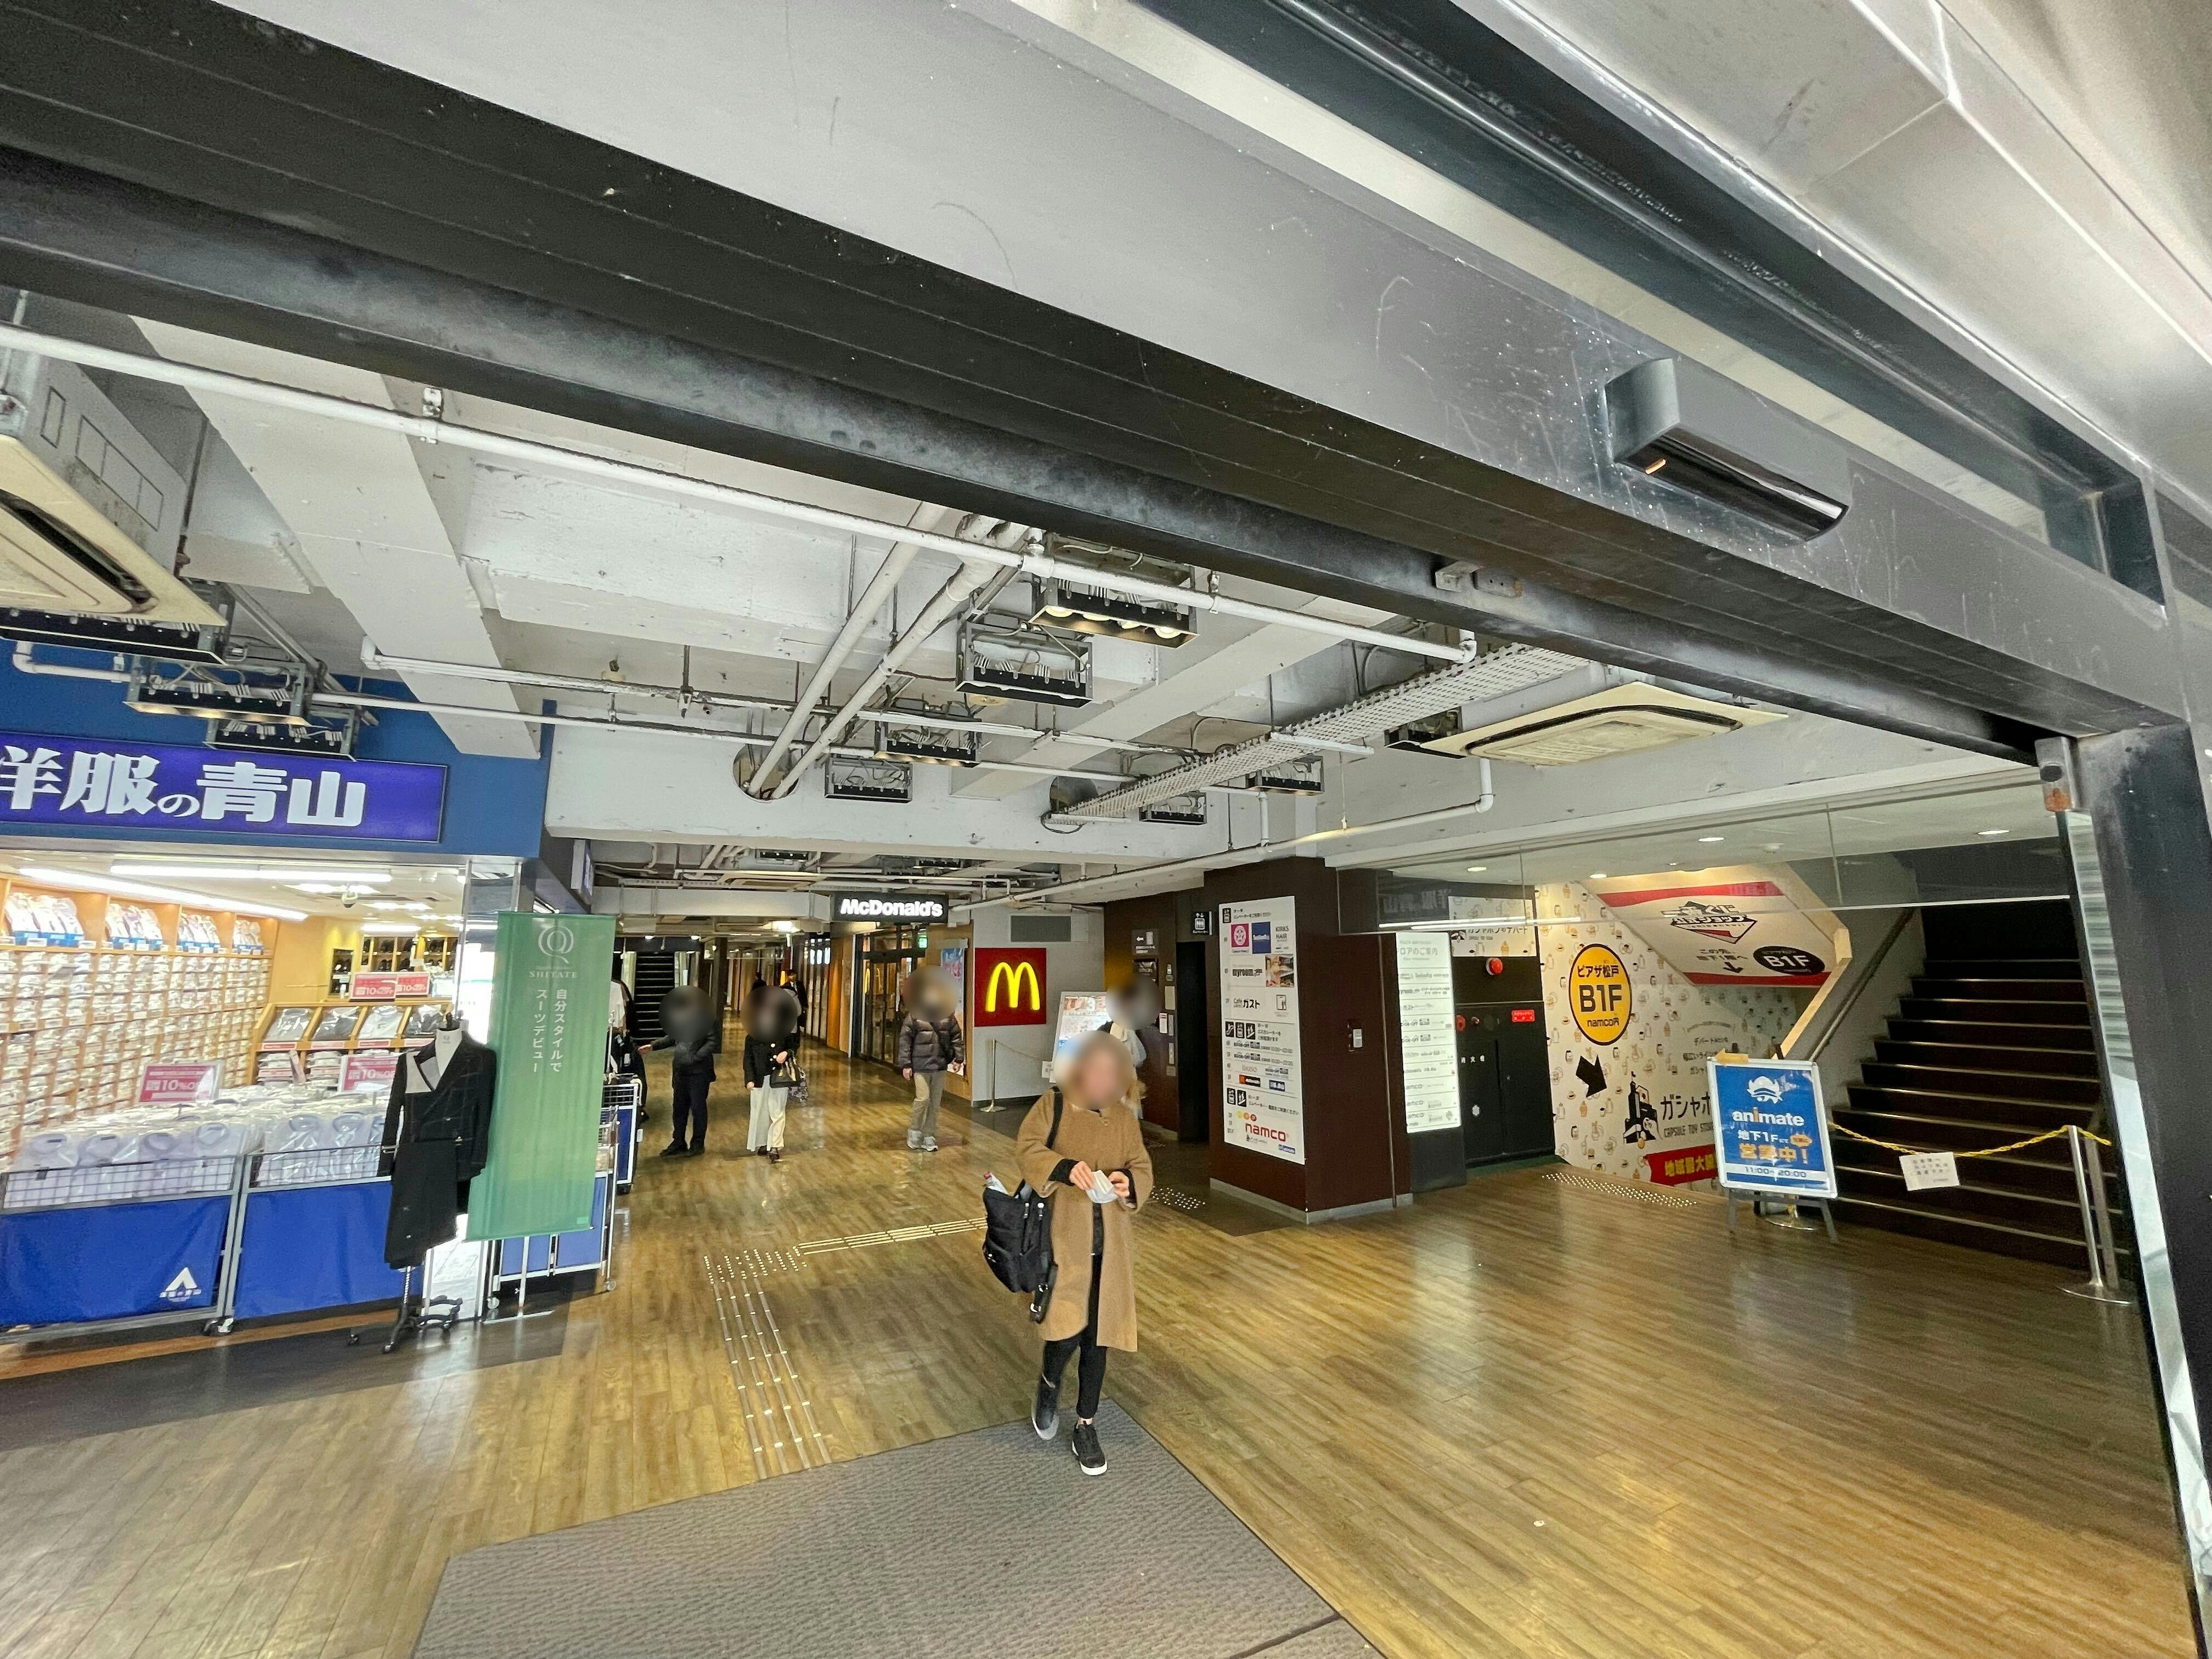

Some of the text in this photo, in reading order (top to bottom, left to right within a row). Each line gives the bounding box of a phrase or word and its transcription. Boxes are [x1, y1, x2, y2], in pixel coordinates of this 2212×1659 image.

[840, 898, 943, 917] McDonald's
[1763, 955, 1812, 967] B1F
[529, 970, 578, 979] SHITATE
[1577, 965, 1619, 978] ピアザ松戸
[1579, 984, 1622, 1012] B1F
[532, 989, 548, 1073] スーツデビュー
[550, 989, 567, 1073] 自分スタイルで
[1733, 1107, 1805, 1126] animate
[1245, 1123, 1286, 1142] namco
